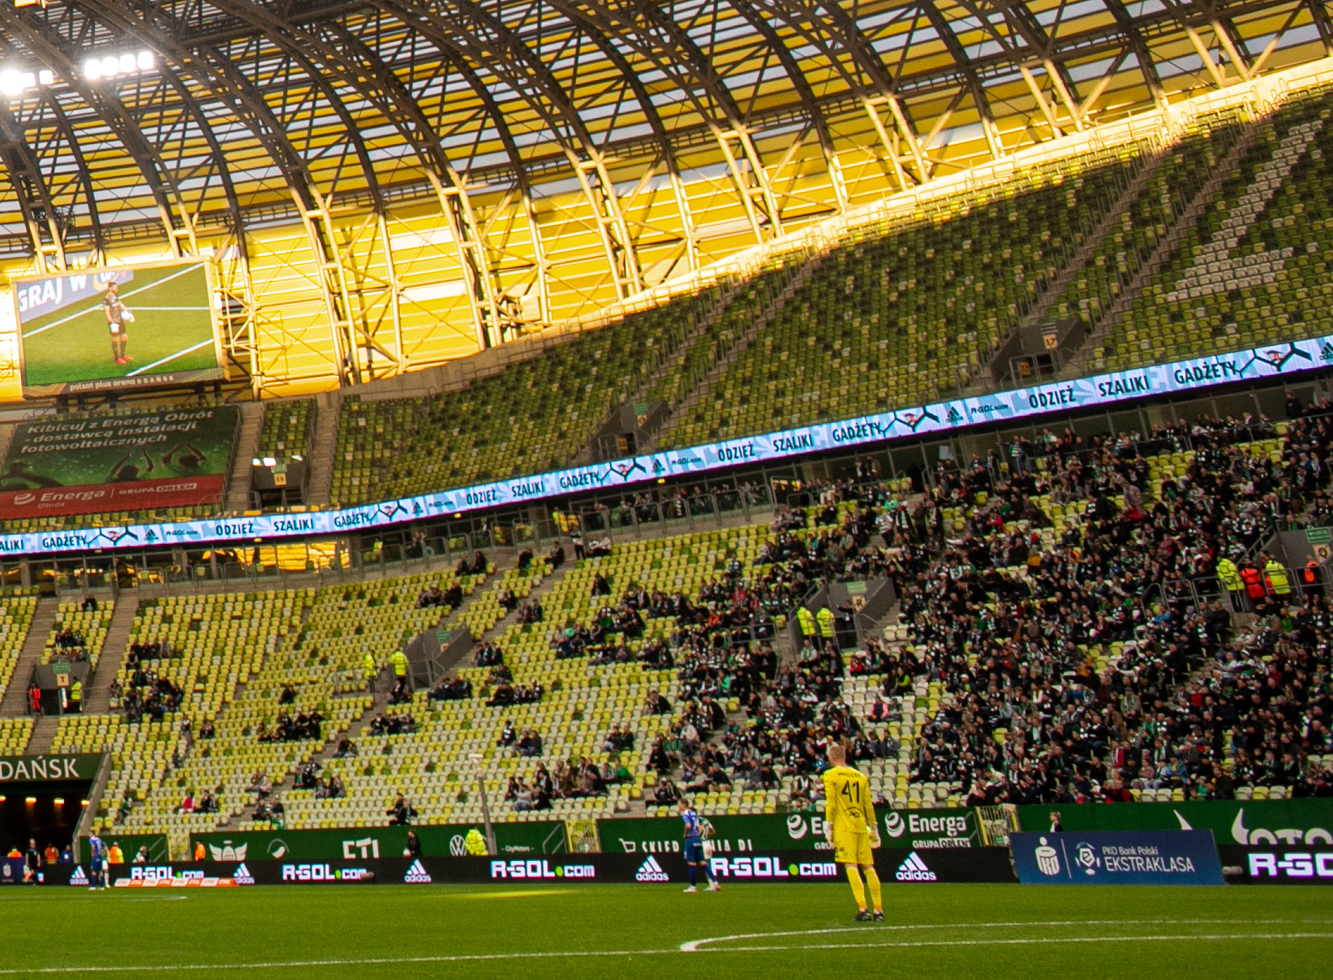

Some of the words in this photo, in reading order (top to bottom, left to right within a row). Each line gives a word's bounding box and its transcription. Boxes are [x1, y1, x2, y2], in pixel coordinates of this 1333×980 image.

[17, 277, 63, 313] GRAJ
[69, 274, 87, 292] W
[69, 381, 94, 392] polsat
[95, 379, 112, 391] plus
[113, 377, 136, 388] arena
[1029, 385, 1076, 409] ODZIEŻ
[1098, 374, 1150, 398] SZALIKI
[1174, 360, 1237, 386] GADŻETY
[26, 420, 87, 435] Kibicuj
[102, 413, 161, 428] Energą
[164, 409, 214, 421] Obrót
[117, 420, 198, 435] instalacji
[20, 433, 168, 455] fotowoltaicznych
[717, 443, 755, 462] ODZIEŻ
[773, 433, 813, 452] SZALIKI
[832, 421, 882, 443] GADŻETY
[39, 488, 106, 504] Energa
[118, 486, 156, 495] GRUPA
[466, 489, 497, 505] ODZIEŻ
[511, 480, 545, 497] SZALIKI
[559, 470, 601, 490] GADŻETY
[216, 522, 254, 537] ODZIEŻ
[274, 518, 315, 532] SZALIKI
[334, 511, 372, 528] GADŻETY
[42, 534, 88, 549] GADŻETY
[841, 780, 861, 804] 41
[909, 815, 967, 837] Energa
[912, 839, 939, 849] GRUPA
[1102, 846, 1118, 855] PKO
[1119, 846, 1136, 855] Bank
[1137, 846, 1159, 856] Polski
[1104, 856, 1195, 873] EKSTRAKLASA
[70, 878, 90, 886] adidas
[404, 874, 431, 883] adidas
[636, 872, 669, 882] adidas
[895, 869, 937, 881] adidas
